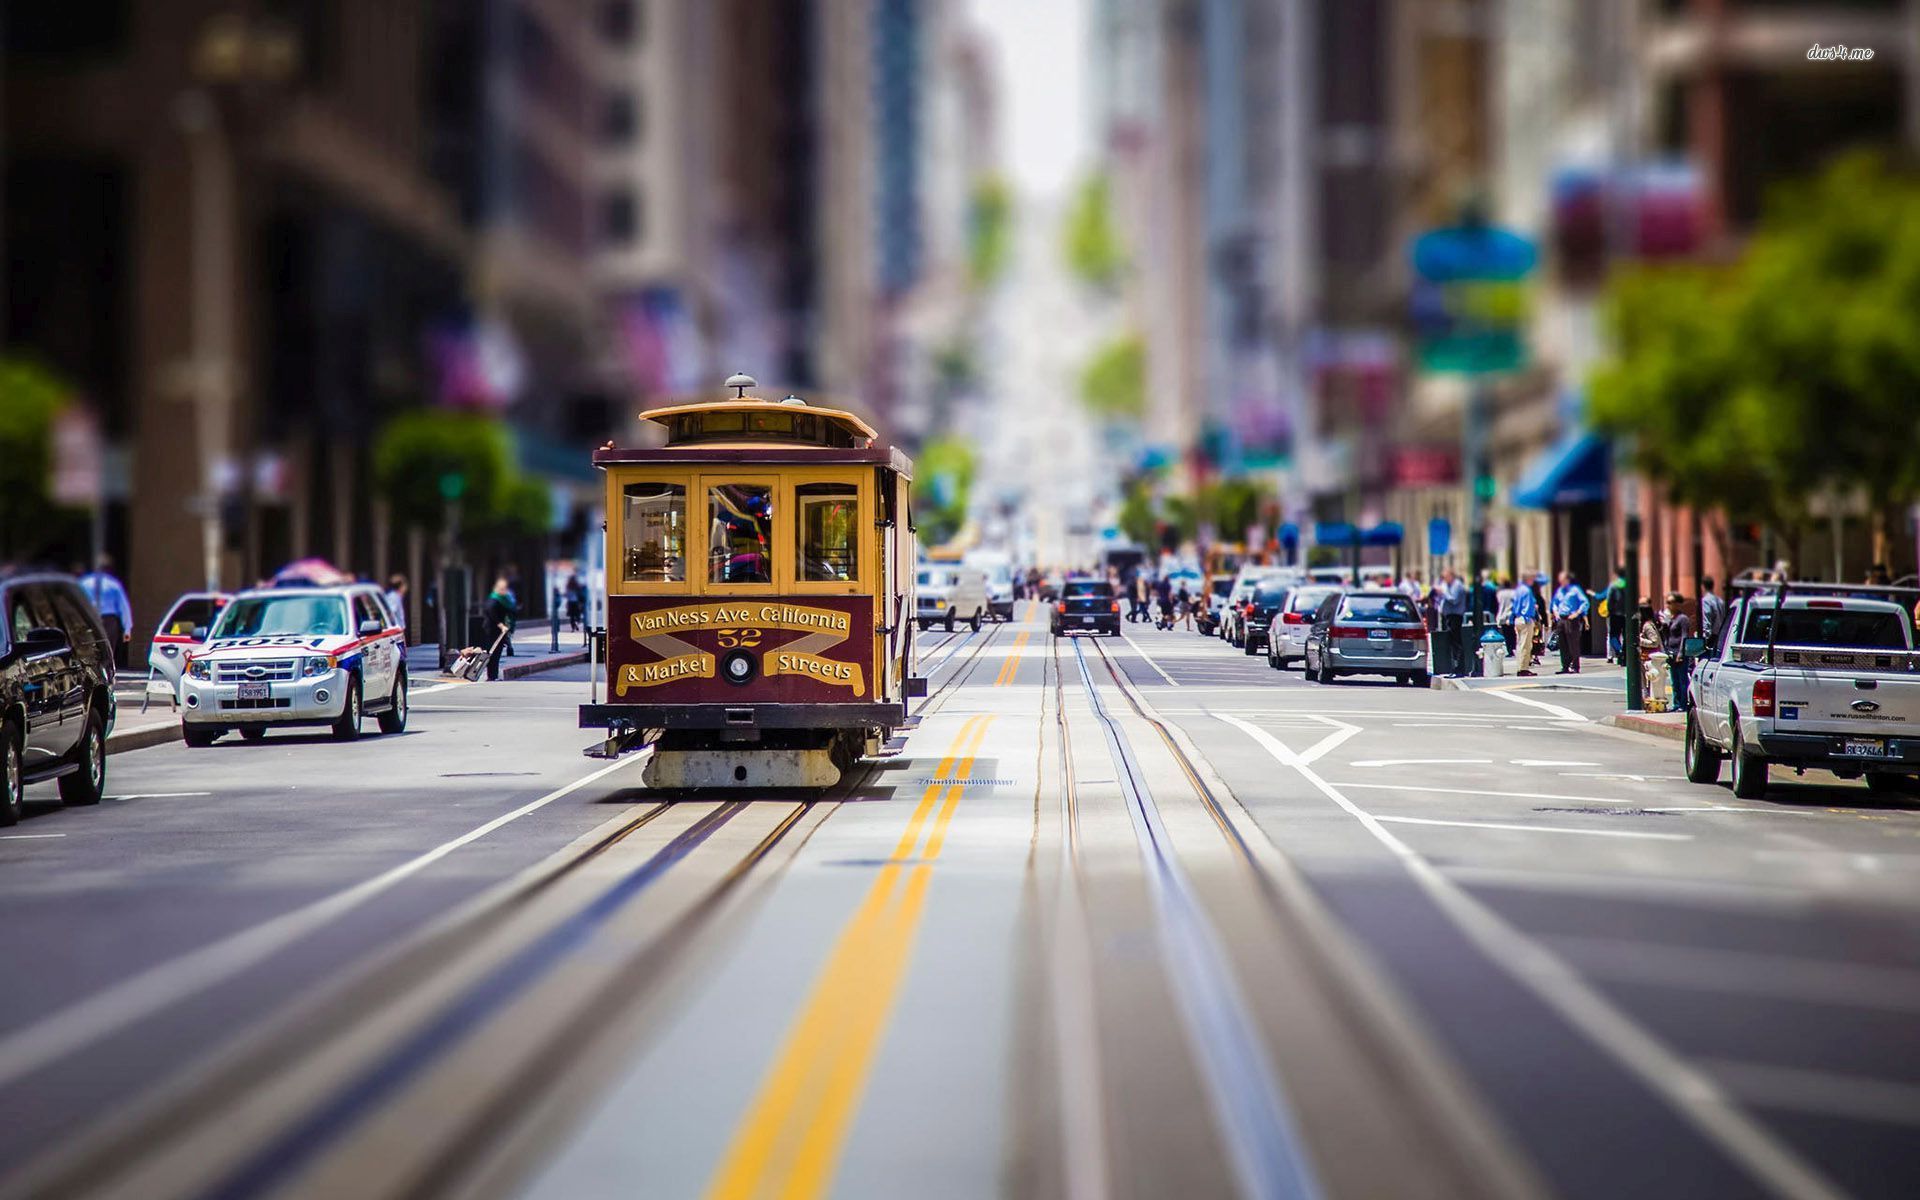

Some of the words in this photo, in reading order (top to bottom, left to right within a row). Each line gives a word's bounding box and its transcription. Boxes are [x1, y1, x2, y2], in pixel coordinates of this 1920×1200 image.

[760, 606, 847, 630] California
[717, 628, 762, 648] 52
[627, 666, 640, 681] &
[644, 657, 707, 681] Market
[778, 655, 852, 680] Streets
[1830, 712, 1906, 722] www.russellhinton.com
